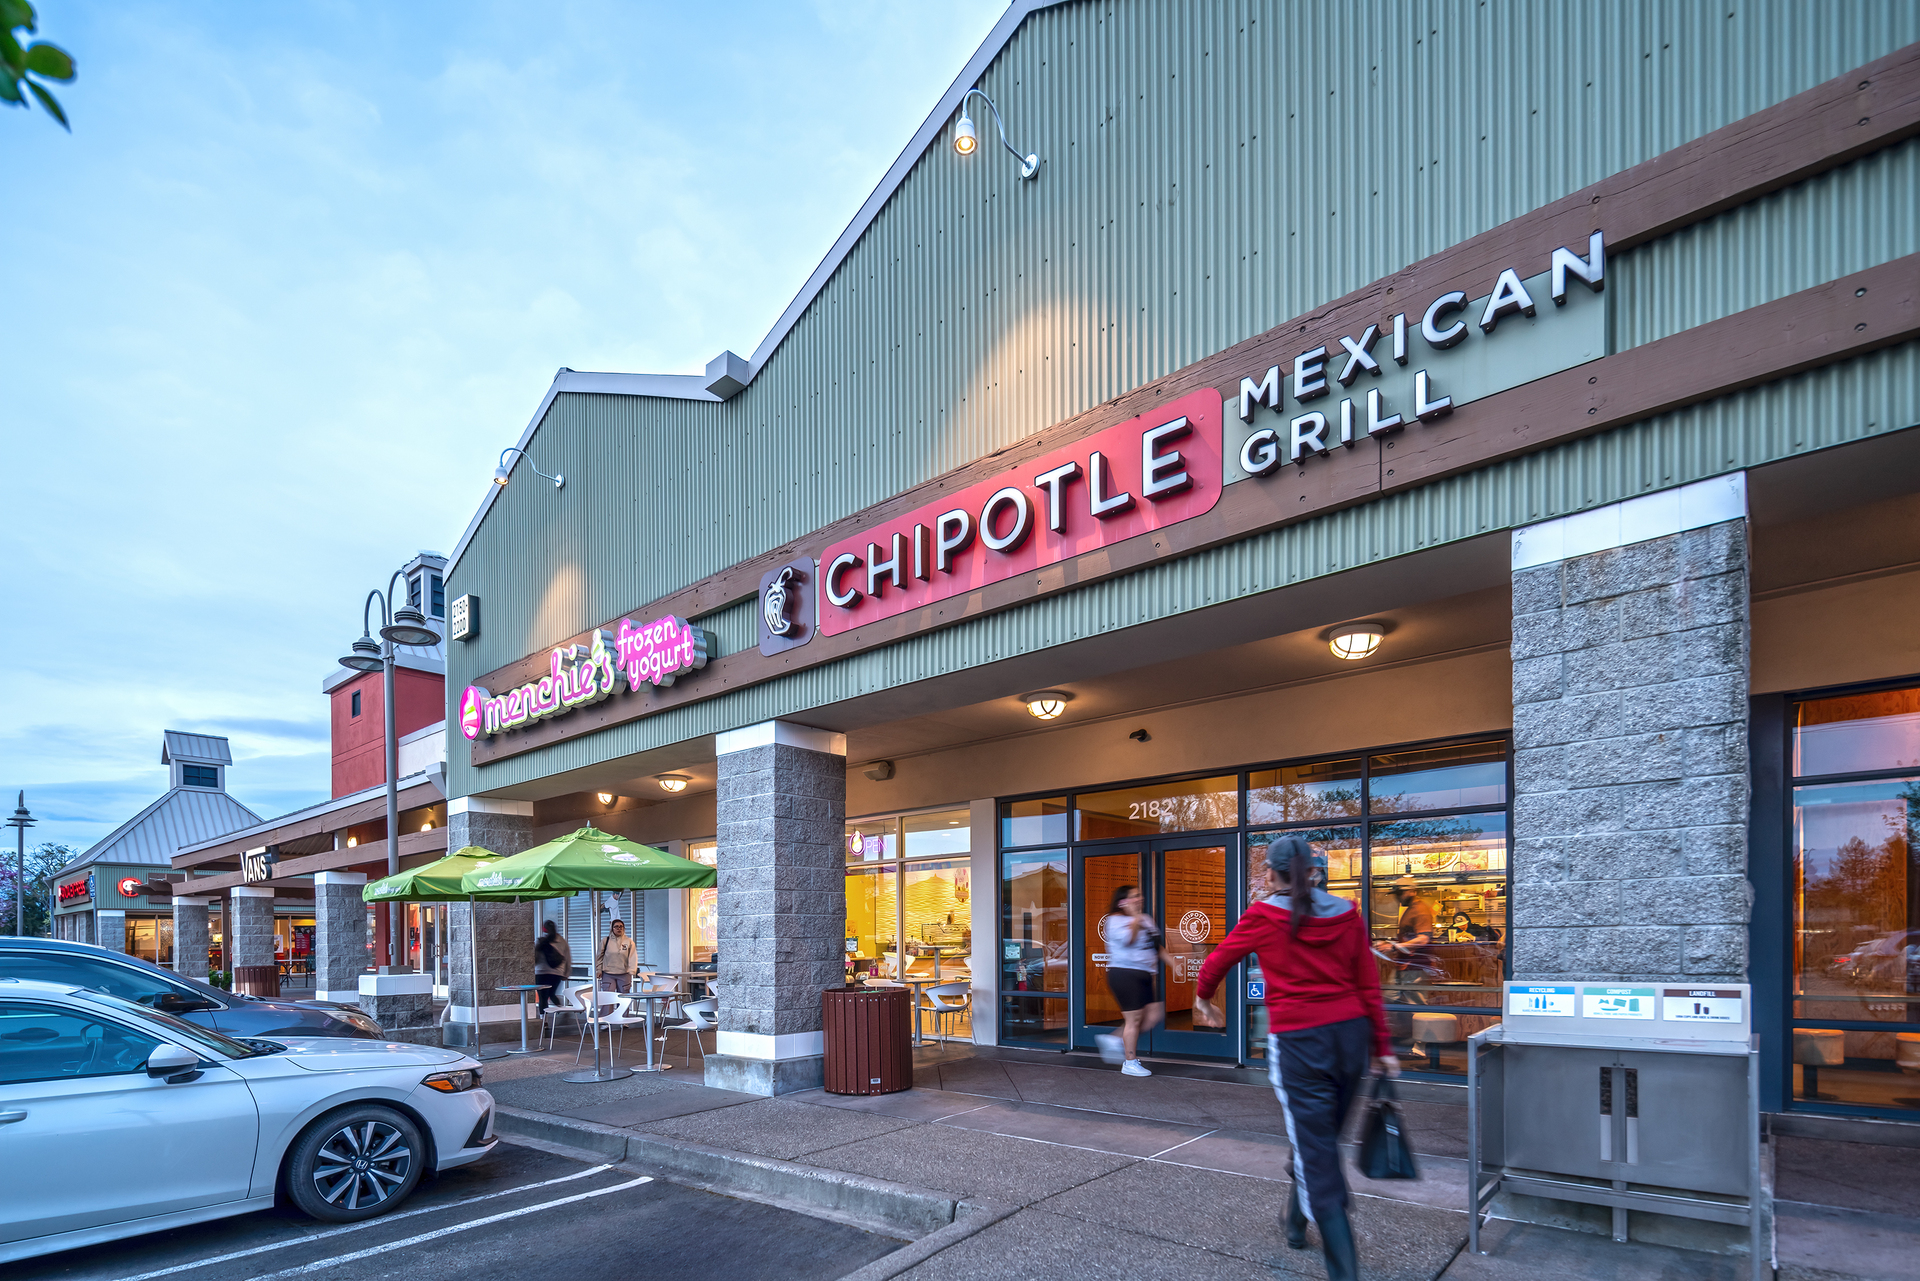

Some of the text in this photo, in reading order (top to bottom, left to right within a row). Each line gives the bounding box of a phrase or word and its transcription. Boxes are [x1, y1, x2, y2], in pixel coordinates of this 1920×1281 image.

[1239, 230, 1605, 424] MEXICAN
[1239, 369, 1454, 478] GRILL
[825, 416, 1193, 608] CHIPOTLE
[453, 617, 467, 635] 2200
[618, 619, 677, 665] frozen
[629, 627, 692, 686] yogurt
[485, 629, 614, 733] menchie's
[1129, 799, 1172, 820] 2182
[240, 846, 267, 883] VANS
[850, 833, 888, 857] OPEN
[1182, 912, 1208, 925] CHIPOTLE
